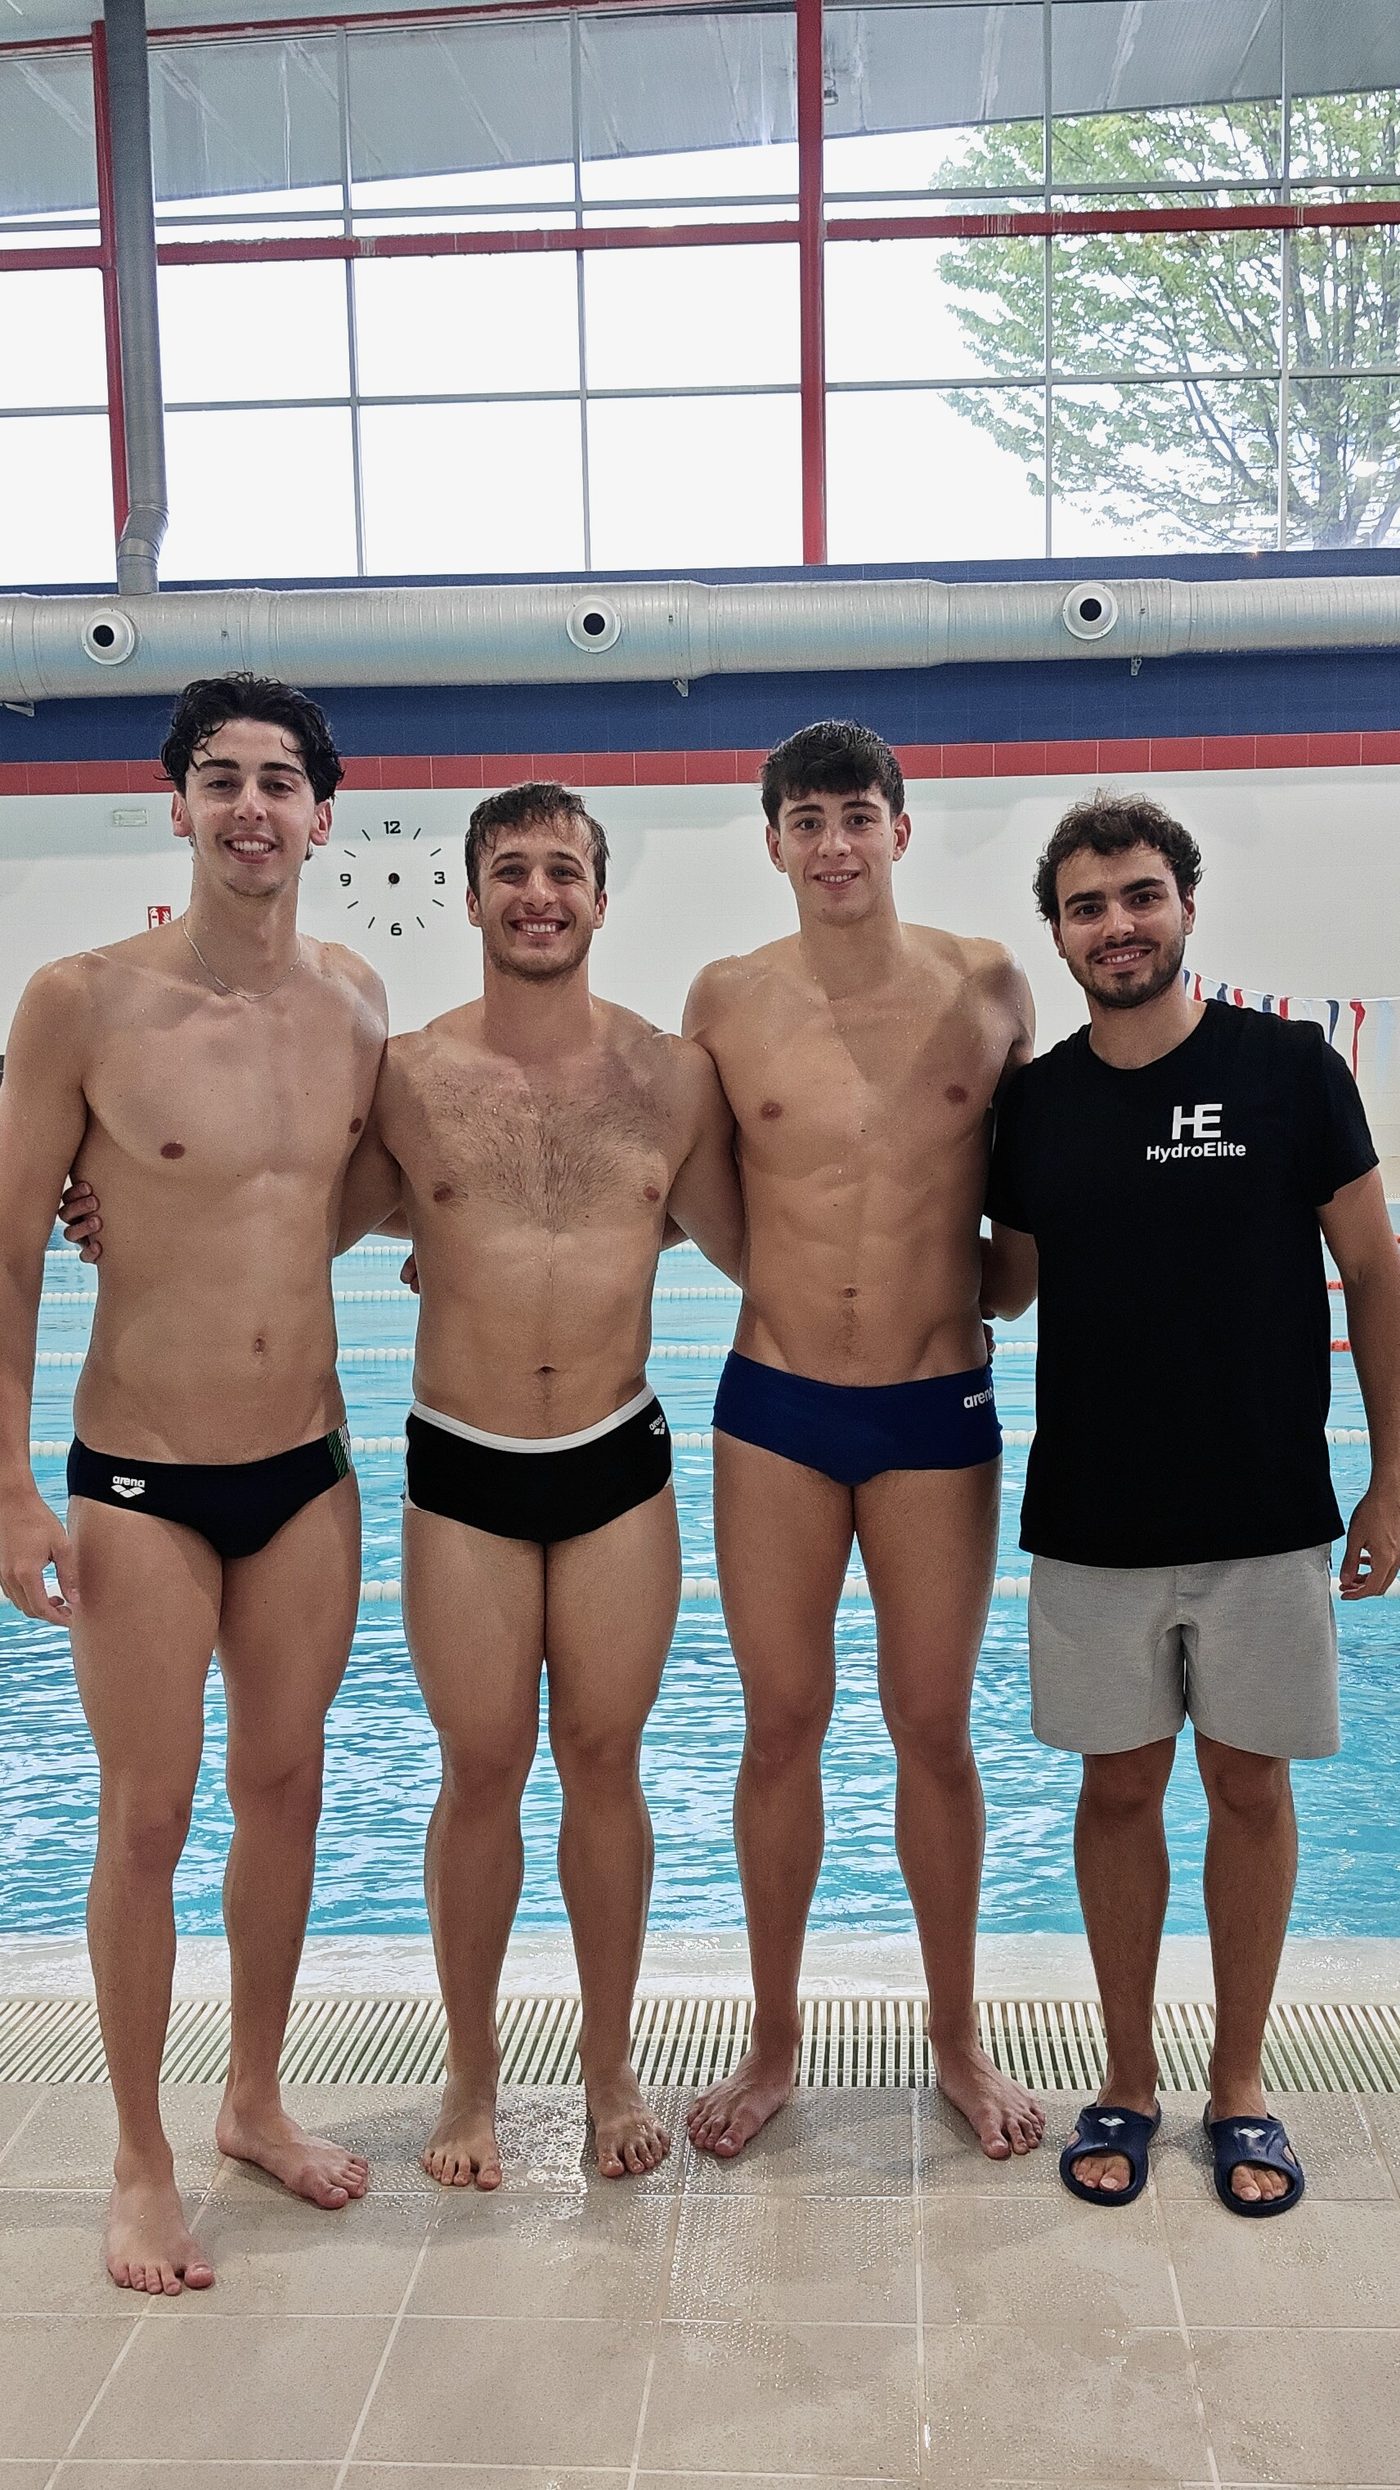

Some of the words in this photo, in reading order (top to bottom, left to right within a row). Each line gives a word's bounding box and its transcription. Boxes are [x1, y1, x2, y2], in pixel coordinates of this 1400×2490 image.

[383, 821, 401, 834] 12
[340, 873, 351, 886] 9
[434, 871, 446, 885] 3
[390, 922, 402, 936] 6
[1172, 1103, 1223, 1140] HE
[1146, 1141, 1247, 1164] HydroElite
[112, 1475, 145, 1488] arena
